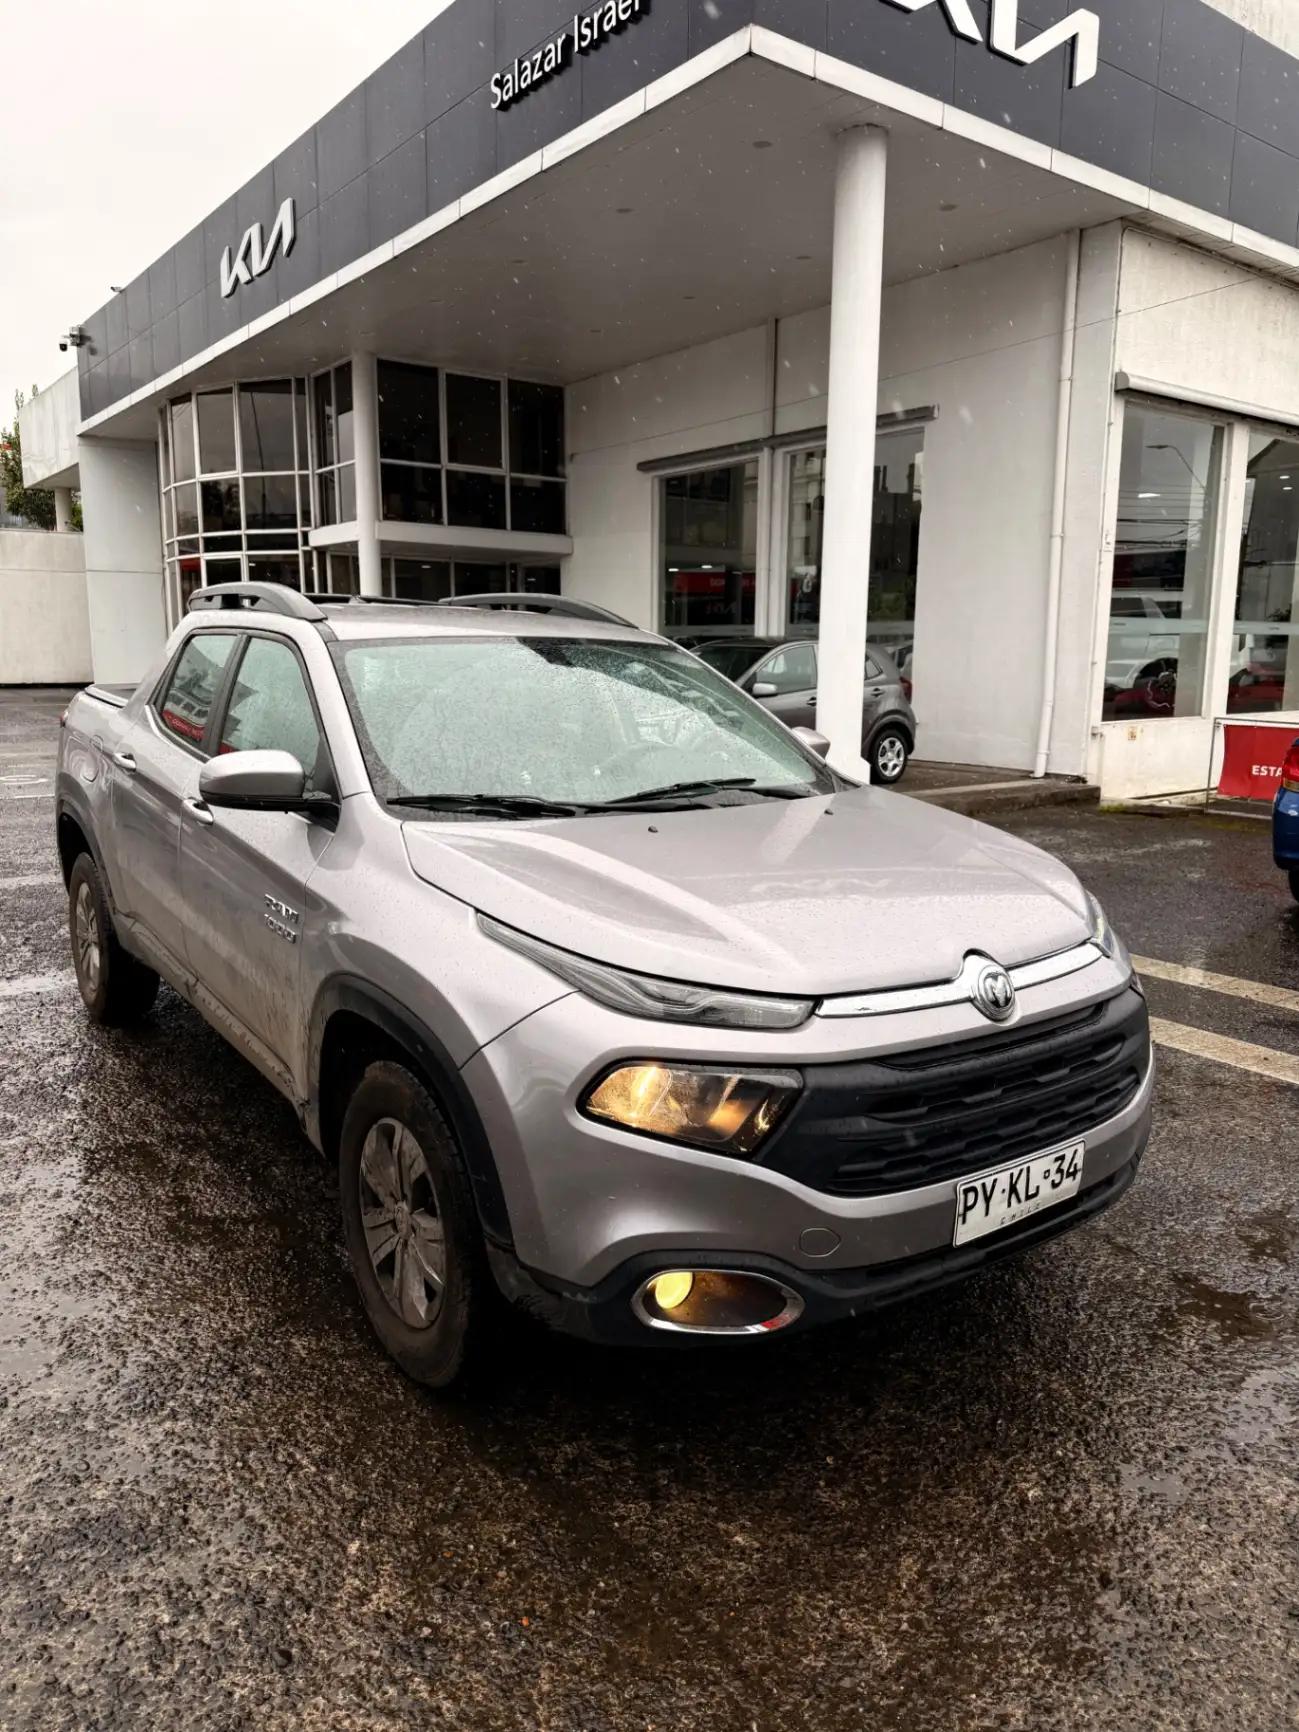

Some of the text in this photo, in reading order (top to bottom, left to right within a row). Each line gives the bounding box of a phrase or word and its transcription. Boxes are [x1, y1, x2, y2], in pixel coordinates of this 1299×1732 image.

[490, 0, 640, 109] Salazar Israe
[220, 197, 294, 298] KIA
